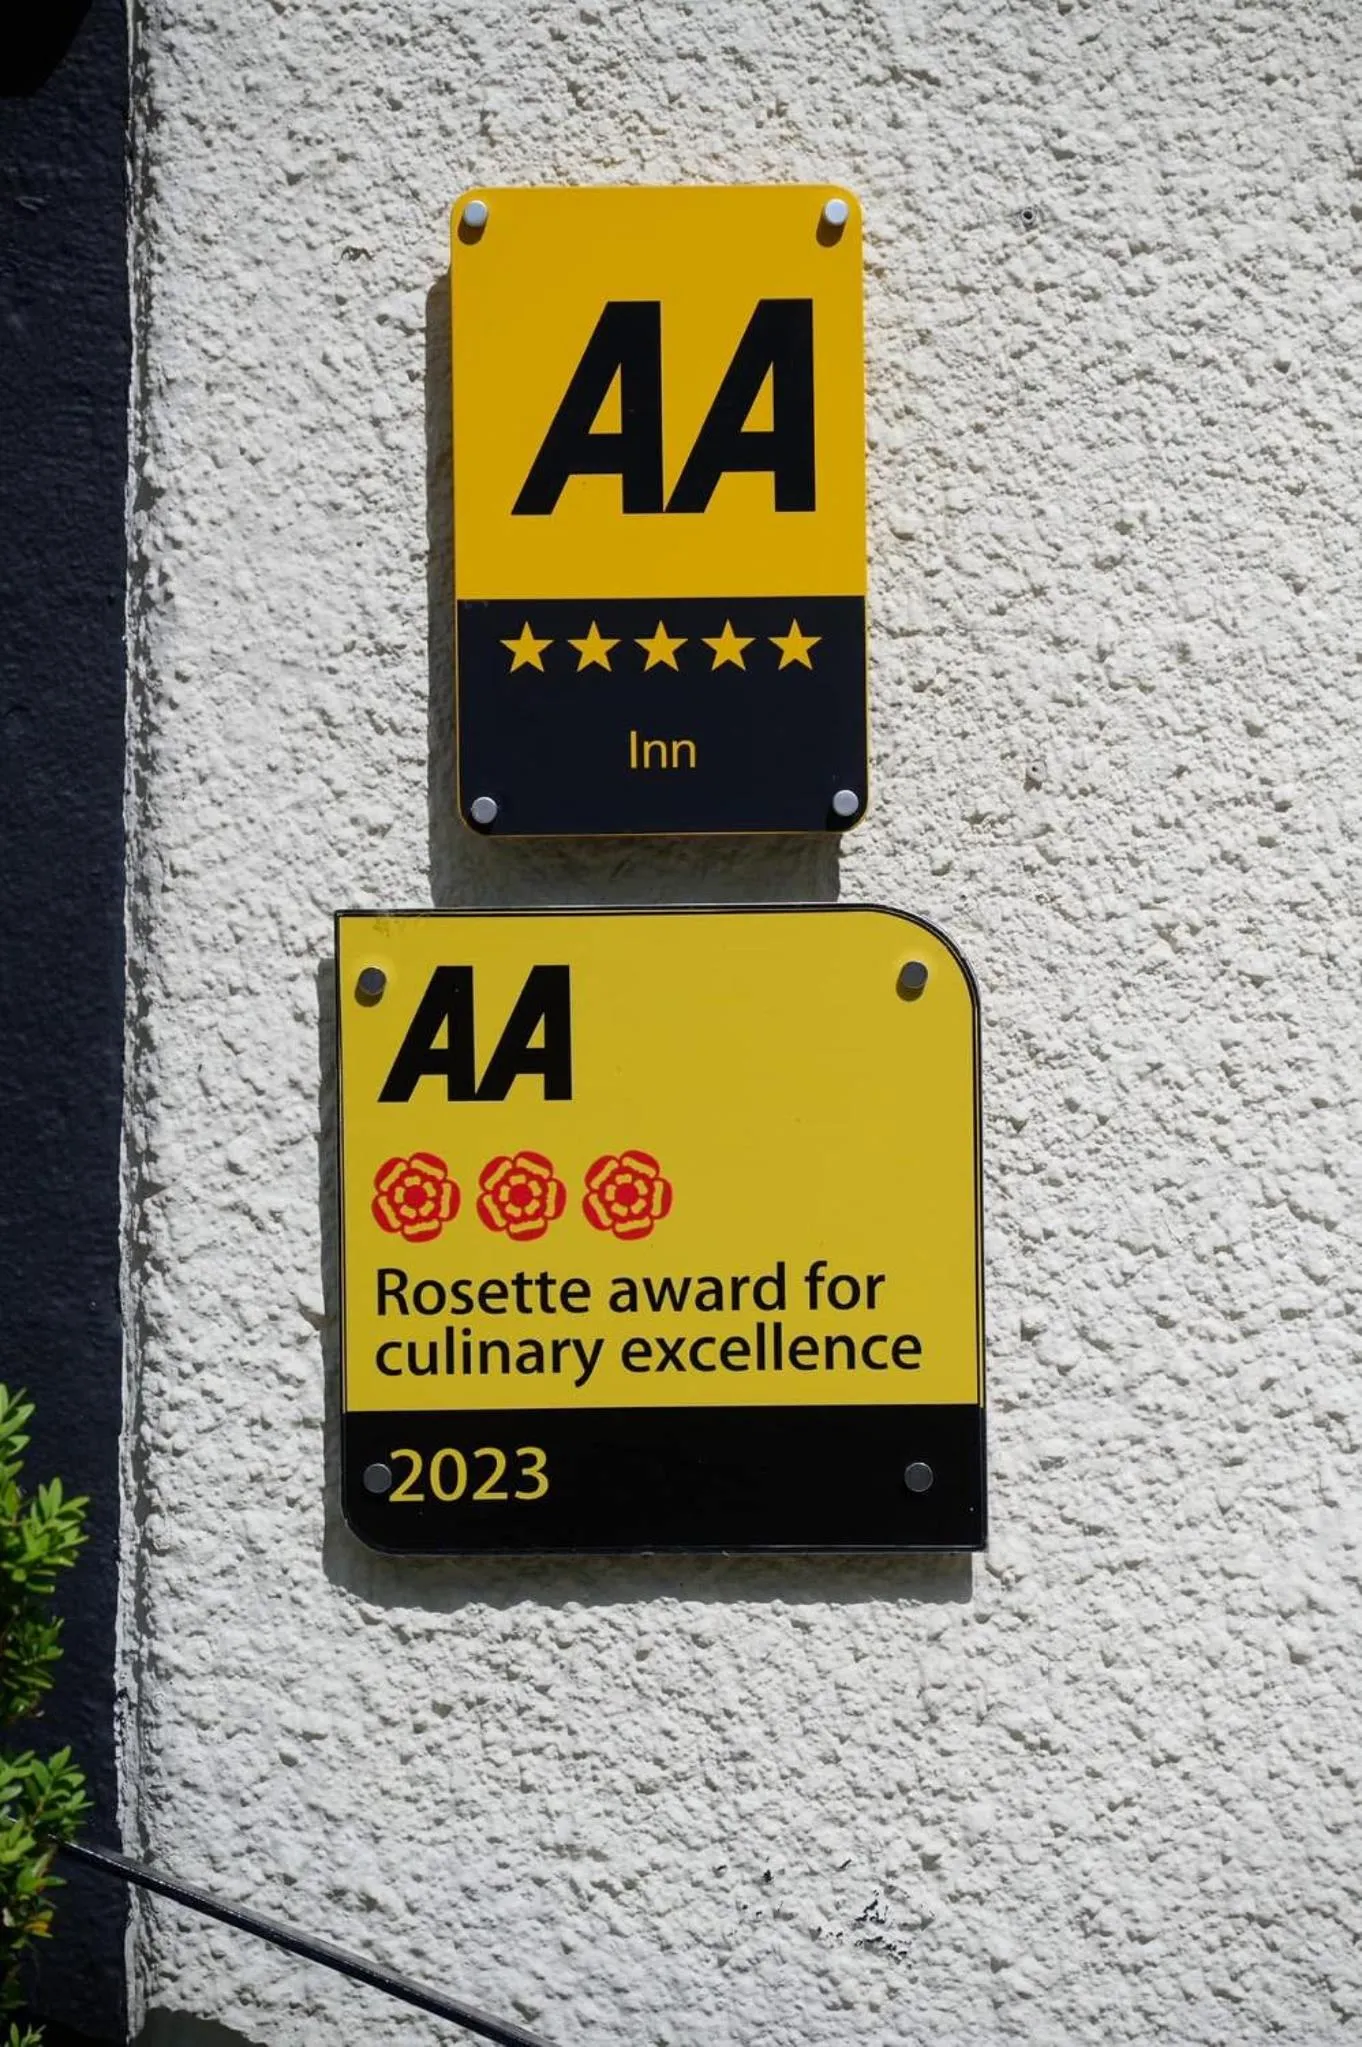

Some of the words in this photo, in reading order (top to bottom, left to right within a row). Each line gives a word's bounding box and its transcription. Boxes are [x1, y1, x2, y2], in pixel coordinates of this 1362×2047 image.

[510, 298, 816, 516] AA
[629, 730, 698, 769] Inn
[378, 964, 573, 1103] AA
[376, 1267, 592, 1316] Rosette
[608, 1261, 787, 1314] award
[804, 1260, 886, 1311] for
[375, 1325, 605, 1388] culinary
[621, 1321, 922, 1373] excellence
[388, 1446, 549, 1502] 2023
